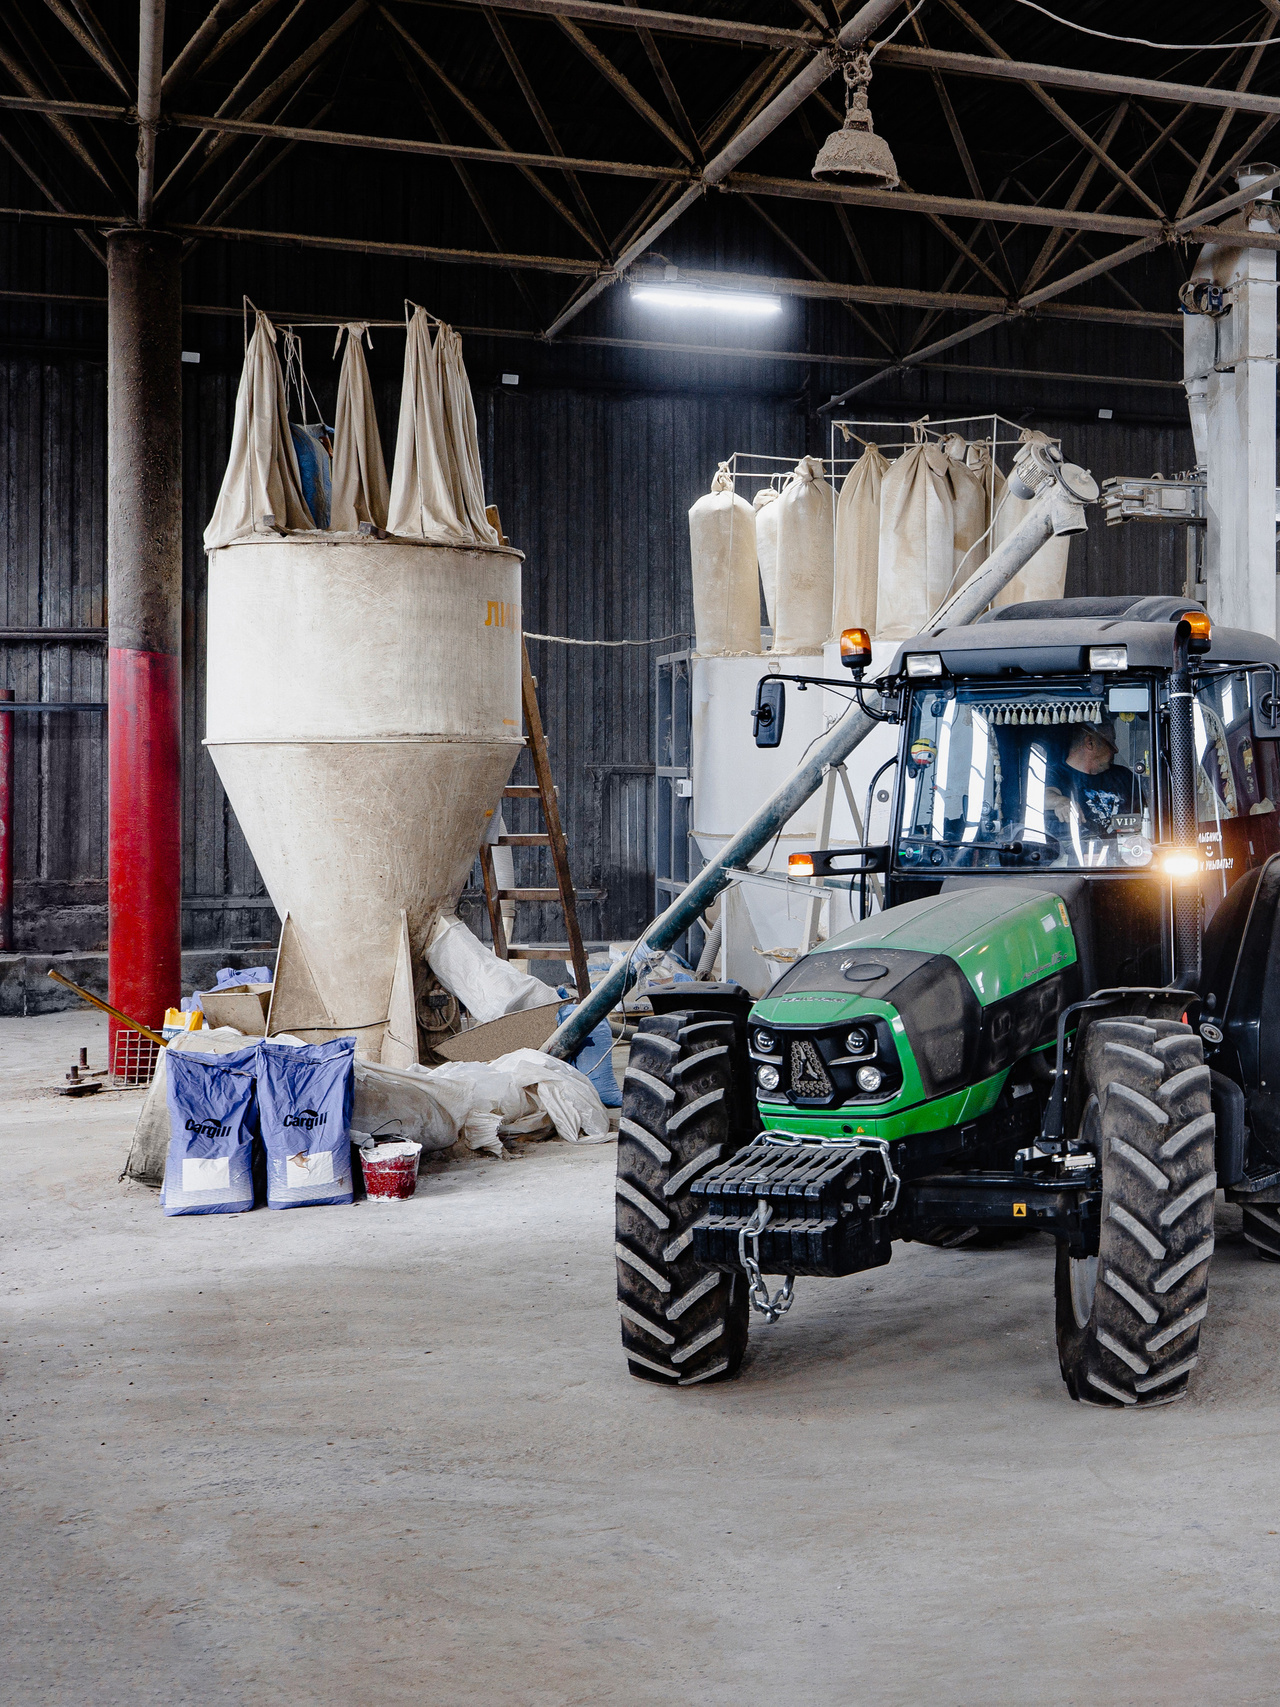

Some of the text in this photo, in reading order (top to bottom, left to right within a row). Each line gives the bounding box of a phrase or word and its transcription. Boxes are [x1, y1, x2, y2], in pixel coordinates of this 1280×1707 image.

[1116, 818, 1137, 826] VIP
[185, 1118, 232, 1139] Cargill
[283, 1110, 328, 1130] Cargill
